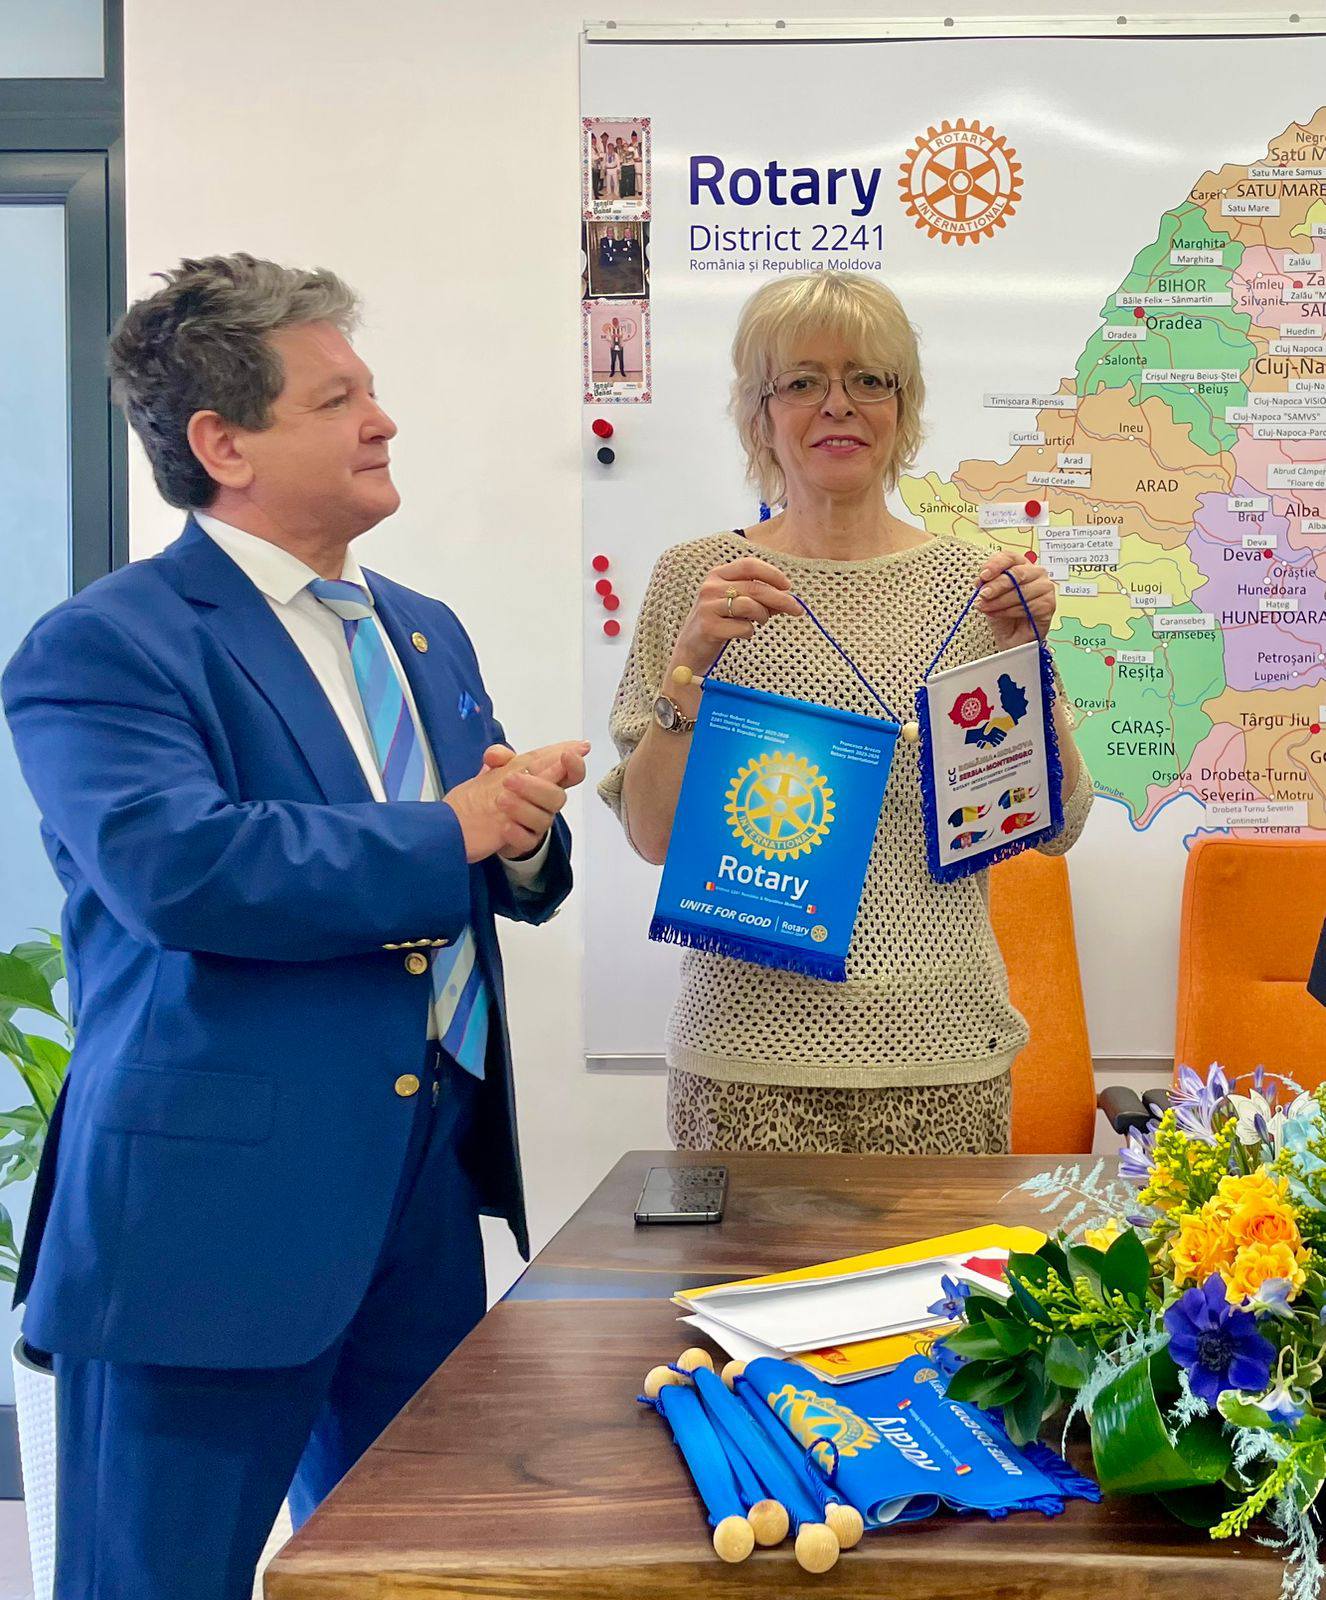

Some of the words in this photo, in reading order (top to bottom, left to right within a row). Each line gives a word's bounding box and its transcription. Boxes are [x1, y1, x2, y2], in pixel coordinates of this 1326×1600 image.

[935, 132, 987, 148] ROTARY
[1271, 147, 1306, 161] Satu
[1252, 168, 1270, 177] Satu
[1272, 168, 1294, 177] Mare
[1296, 168, 1322, 176] Samus
[690, 155, 882, 216] Rotary
[1237, 184, 1277, 198] SATU
[1282, 183, 1326, 197] MARE
[1190, 189, 1221, 200] Carei
[1228, 204, 1246, 212] Satu
[1248, 204, 1270, 212] Mare
[918, 201, 1005, 232] INTERNATIONAL
[690, 224, 802, 251] District
[811, 224, 884, 251] 2241
[1172, 238, 1226, 250] Marghita
[690, 258, 745, 271] România
[762, 258, 824, 273] Republica
[827, 258, 882, 270] Moldova
[1177, 255, 1214, 265] Marghita
[1158, 279, 1206, 292] BIHOR
[1144, 294, 1163, 303] Felix
[1171, 294, 1213, 304] Sânmartin
[1146, 316, 1202, 330] Oradea
[1107, 331, 1137, 339] Oradea
[1286, 327, 1316, 336] Huedin
[1274, 344, 1290, 354] Cluj
[1292, 345, 1323, 354] Napoca
[1104, 355, 1148, 366] Salonta
[1170, 372, 1195, 382] Negru
[1198, 384, 1229, 397] Beiuș
[991, 397, 1030, 407] Timișoara
[1032, 398, 1065, 408] Ripensis
[1254, 397, 1303, 406] Cluj-Napoca
[1232, 412, 1282, 421] Cluj-Napoca
[1118, 422, 1144, 433] Ineu
[1012, 433, 1039, 441] Curtici
[1045, 436, 1075, 446] urtici
[1063, 456, 1083, 465] Arad
[1273, 467, 1296, 475] Abrud
[1032, 475, 1049, 484] Arad
[1050, 477, 1075, 486] Cetate
[1135, 480, 1179, 492] ARAD
[1315, 479, 1325, 487] de
[1234, 500, 1254, 508] Brad
[1285, 503, 1320, 517] Alba
[1086, 514, 1124, 526] Lipova
[1238, 511, 1265, 522] Brad
[1045, 529, 1070, 539] Opera
[1072, 528, 1111, 538] Timișoara
[1247, 539, 1267, 547] Deva
[1048, 555, 1087, 564] Timișoara
[1223, 547, 1262, 561] Deva
[1130, 581, 1162, 594] Lugoj
[1237, 584, 1307, 595] Hunedoara
[1135, 596, 1157, 605] Lugoj
[1222, 611, 1326, 624] HUNEDOARA
[1074, 636, 1106, 648] Bocșa
[1257, 651, 1316, 665] Petroșani
[1118, 665, 1164, 682] Reșița
[1254, 671, 1290, 683] Lupeni
[1240, 712, 1284, 730] Târgu
[1288, 712, 1311, 727] Jiu
[1111, 720, 1171, 737] CARAȘ-
[1107, 741, 1175, 756] SEVERIN
[1152, 770, 1192, 784] Orșova
[1201, 767, 1307, 782] Drobeta-Turnu
[1093, 781, 1124, 798] Danube
[1201, 788, 1254, 801] Severin
[1276, 790, 1313, 800] Motru
[1267, 804, 1294, 812] Severin
[1226, 816, 1269, 825] Continental
[738, 815, 814, 849] INTERNATIONAL
[717, 854, 810, 901] Rotary
[679, 898, 713, 914] UNITE
[713, 906, 737, 920] FOR
[738, 912, 772, 928] GOOD
[781, 921, 810, 936] Rotary
